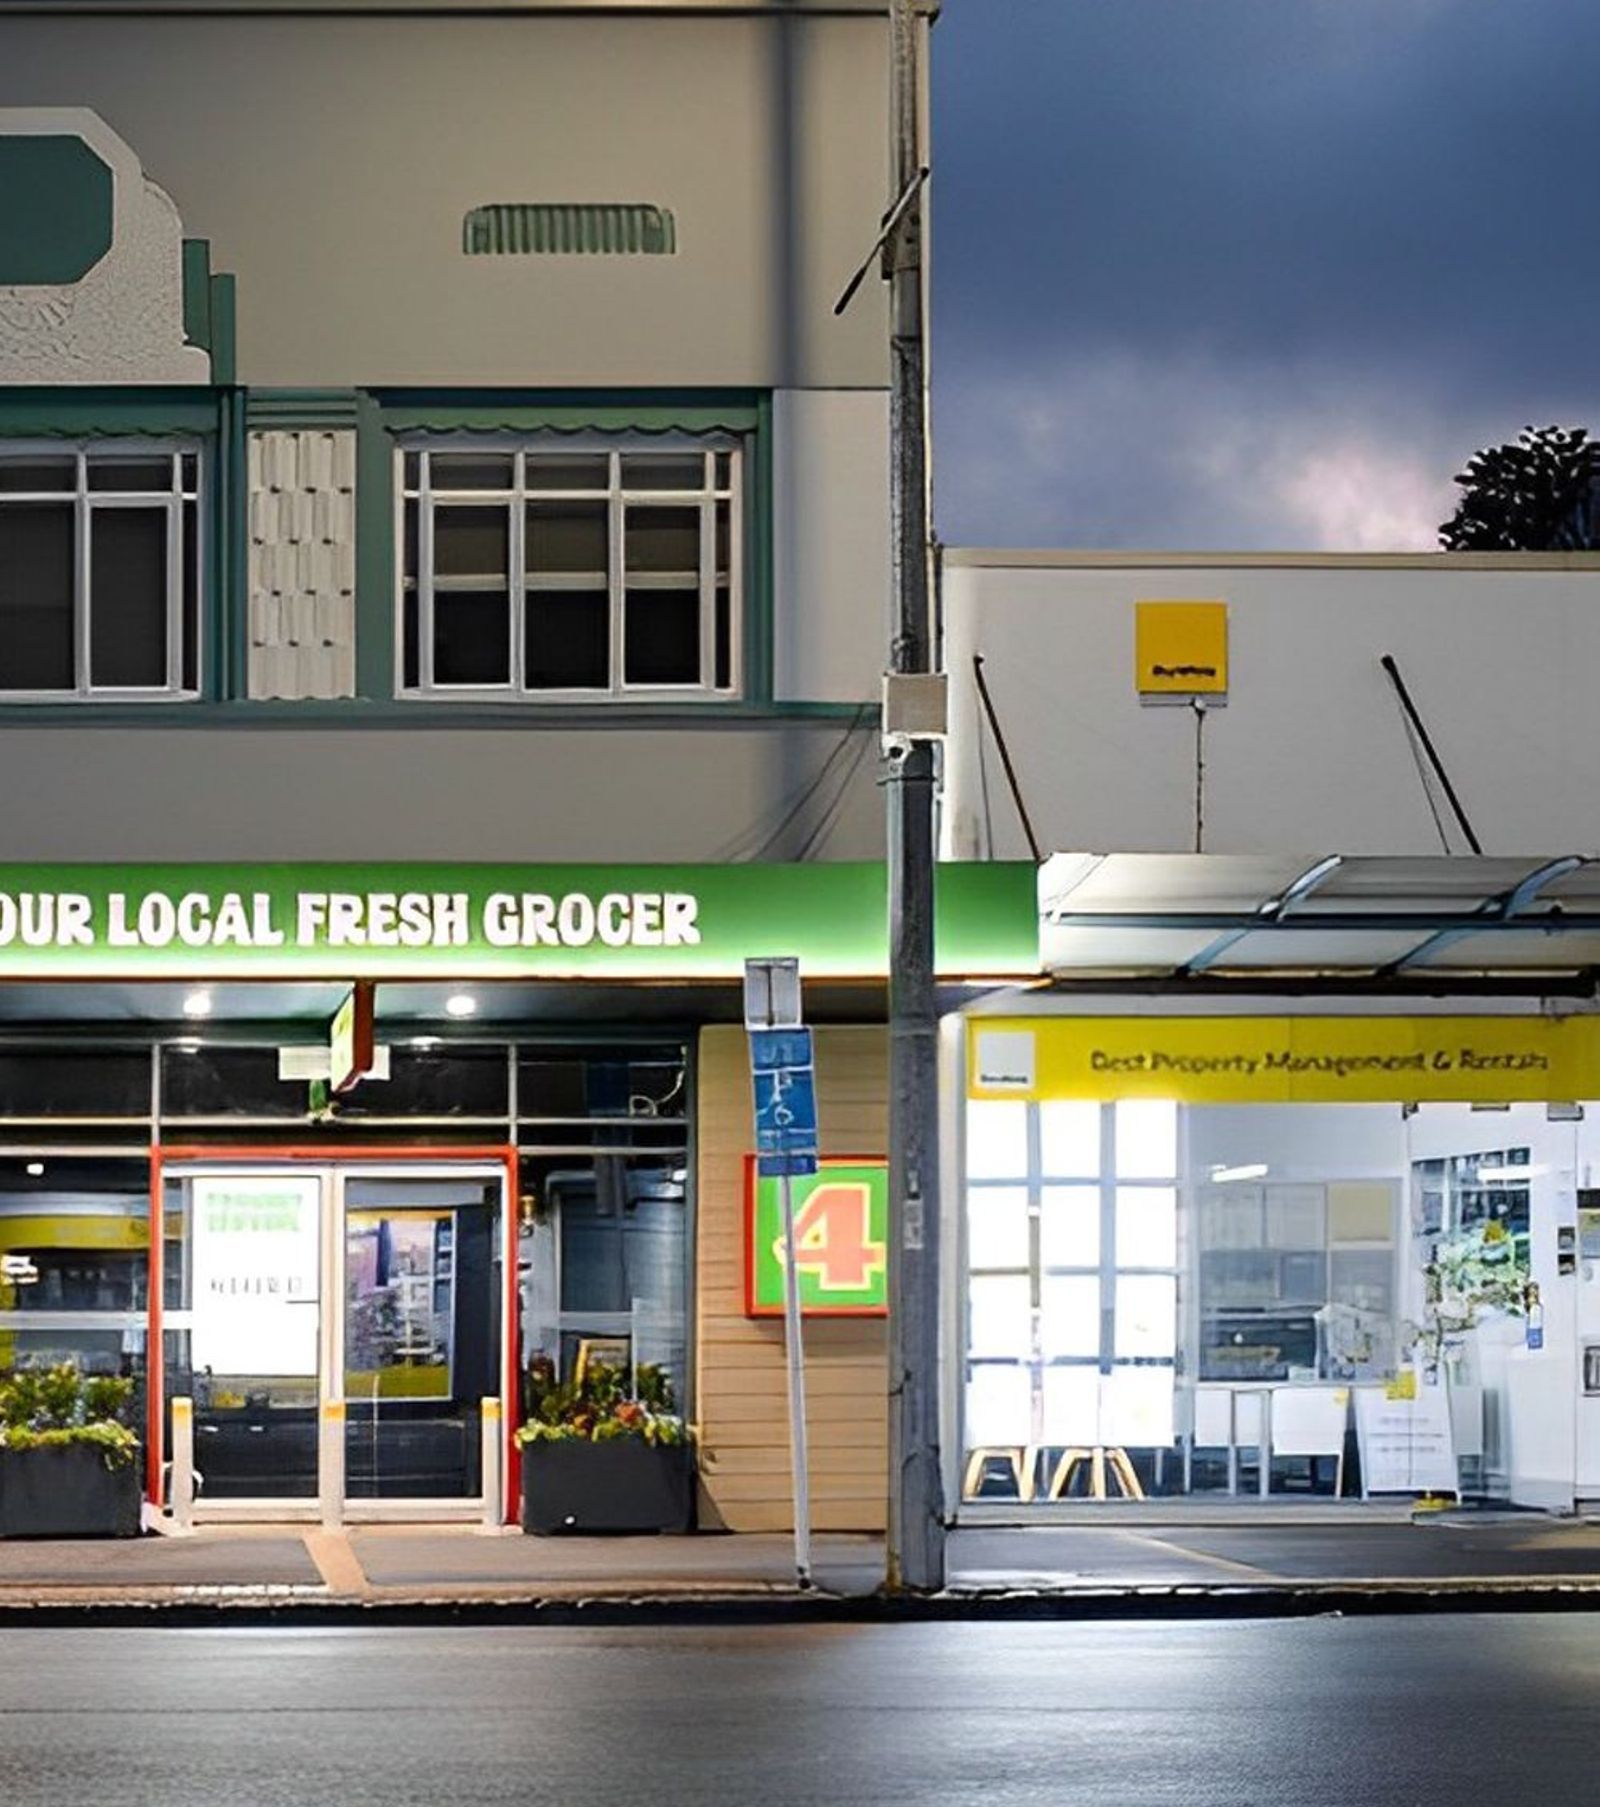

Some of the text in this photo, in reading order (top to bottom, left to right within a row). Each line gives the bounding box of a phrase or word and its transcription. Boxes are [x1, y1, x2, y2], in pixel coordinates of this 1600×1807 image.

[108, 892, 285, 947] LOCAL
[296, 892, 470, 947] FRESH
[483, 892, 701, 947] GROCER
[772, 1182, 886, 1291] 4
